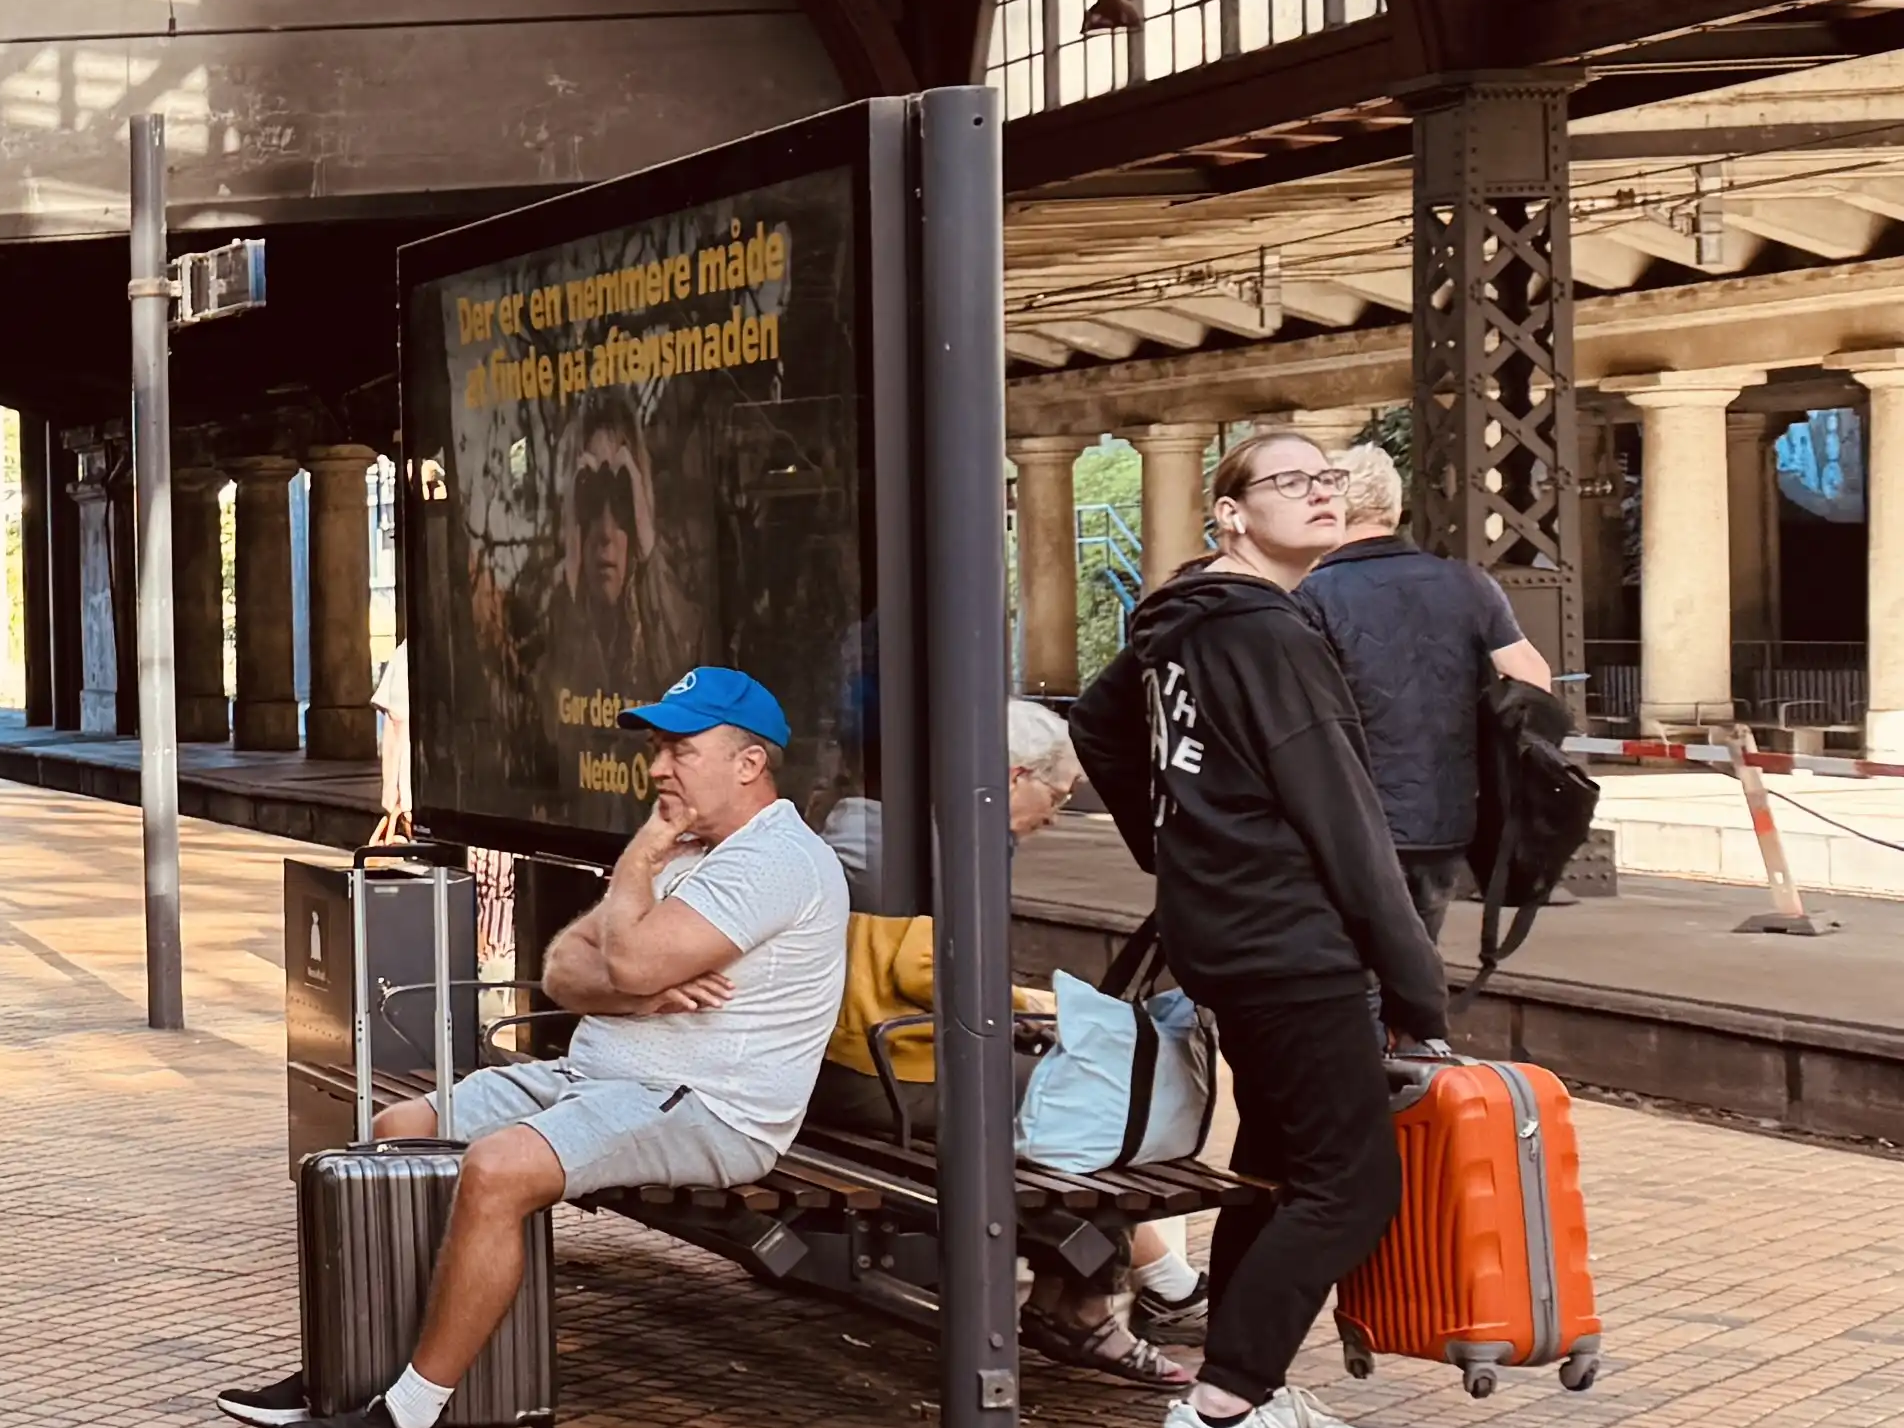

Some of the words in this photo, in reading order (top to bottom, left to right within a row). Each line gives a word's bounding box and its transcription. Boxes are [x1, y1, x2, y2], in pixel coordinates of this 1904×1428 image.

[457, 296, 495, 345] Der
[499, 291, 523, 336] er
[530, 286, 562, 330] en
[567, 254, 690, 322] nemmere
[698, 218, 785, 295] måde
[490, 346, 554, 402] finde
[591, 306, 779, 387] aftensmaden
[590, 688, 621, 728] det
[580, 752, 629, 794] Netto
